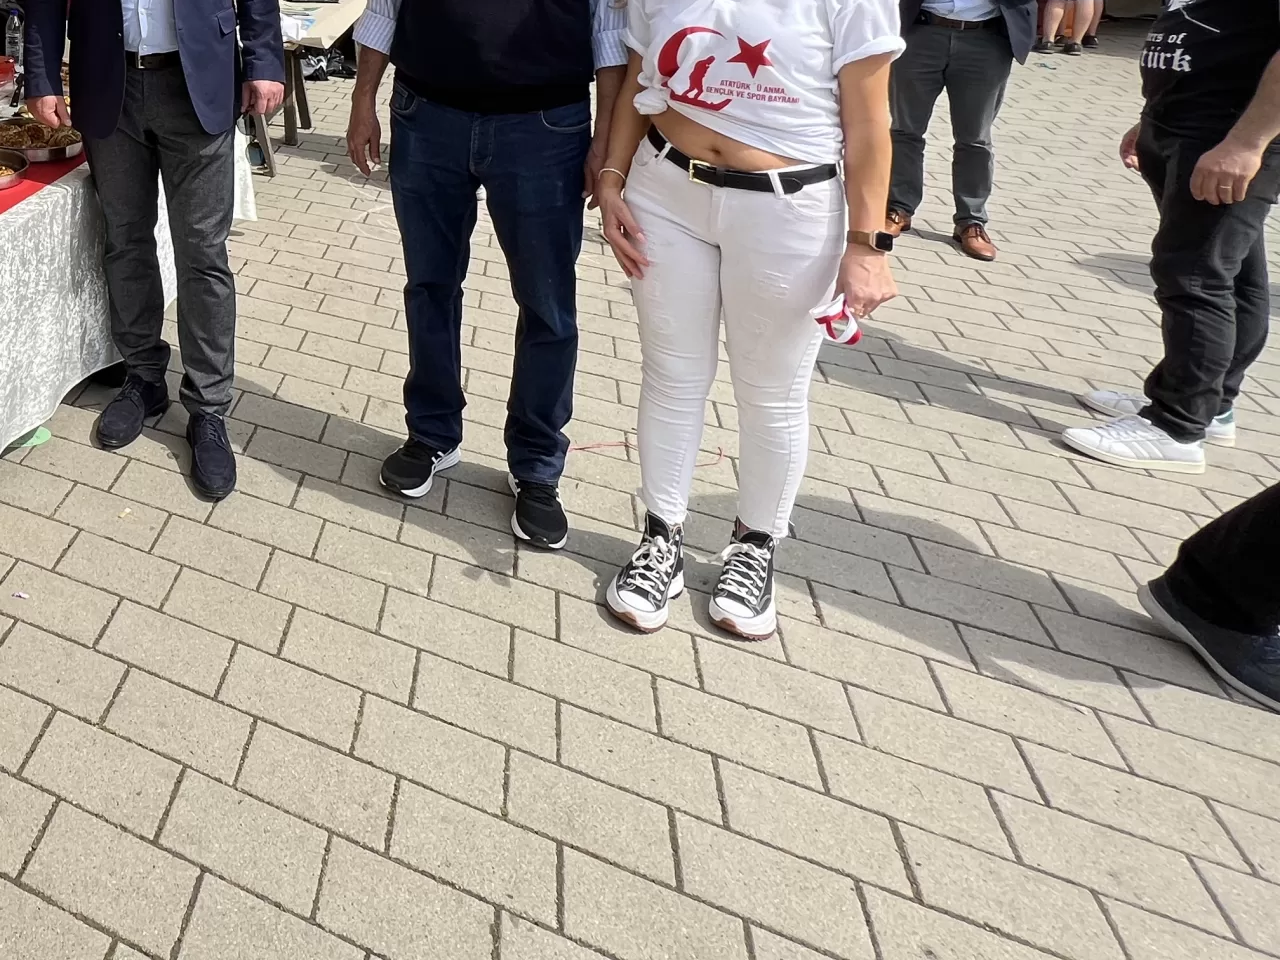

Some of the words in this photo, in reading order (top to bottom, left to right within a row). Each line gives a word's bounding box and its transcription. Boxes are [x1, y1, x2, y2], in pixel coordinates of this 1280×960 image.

[1167, 32, 1188, 44] of
[720, 79, 751, 90] ATATÜRK
[736, 91, 745, 99] VE
[746, 92, 766, 102] SPOR
